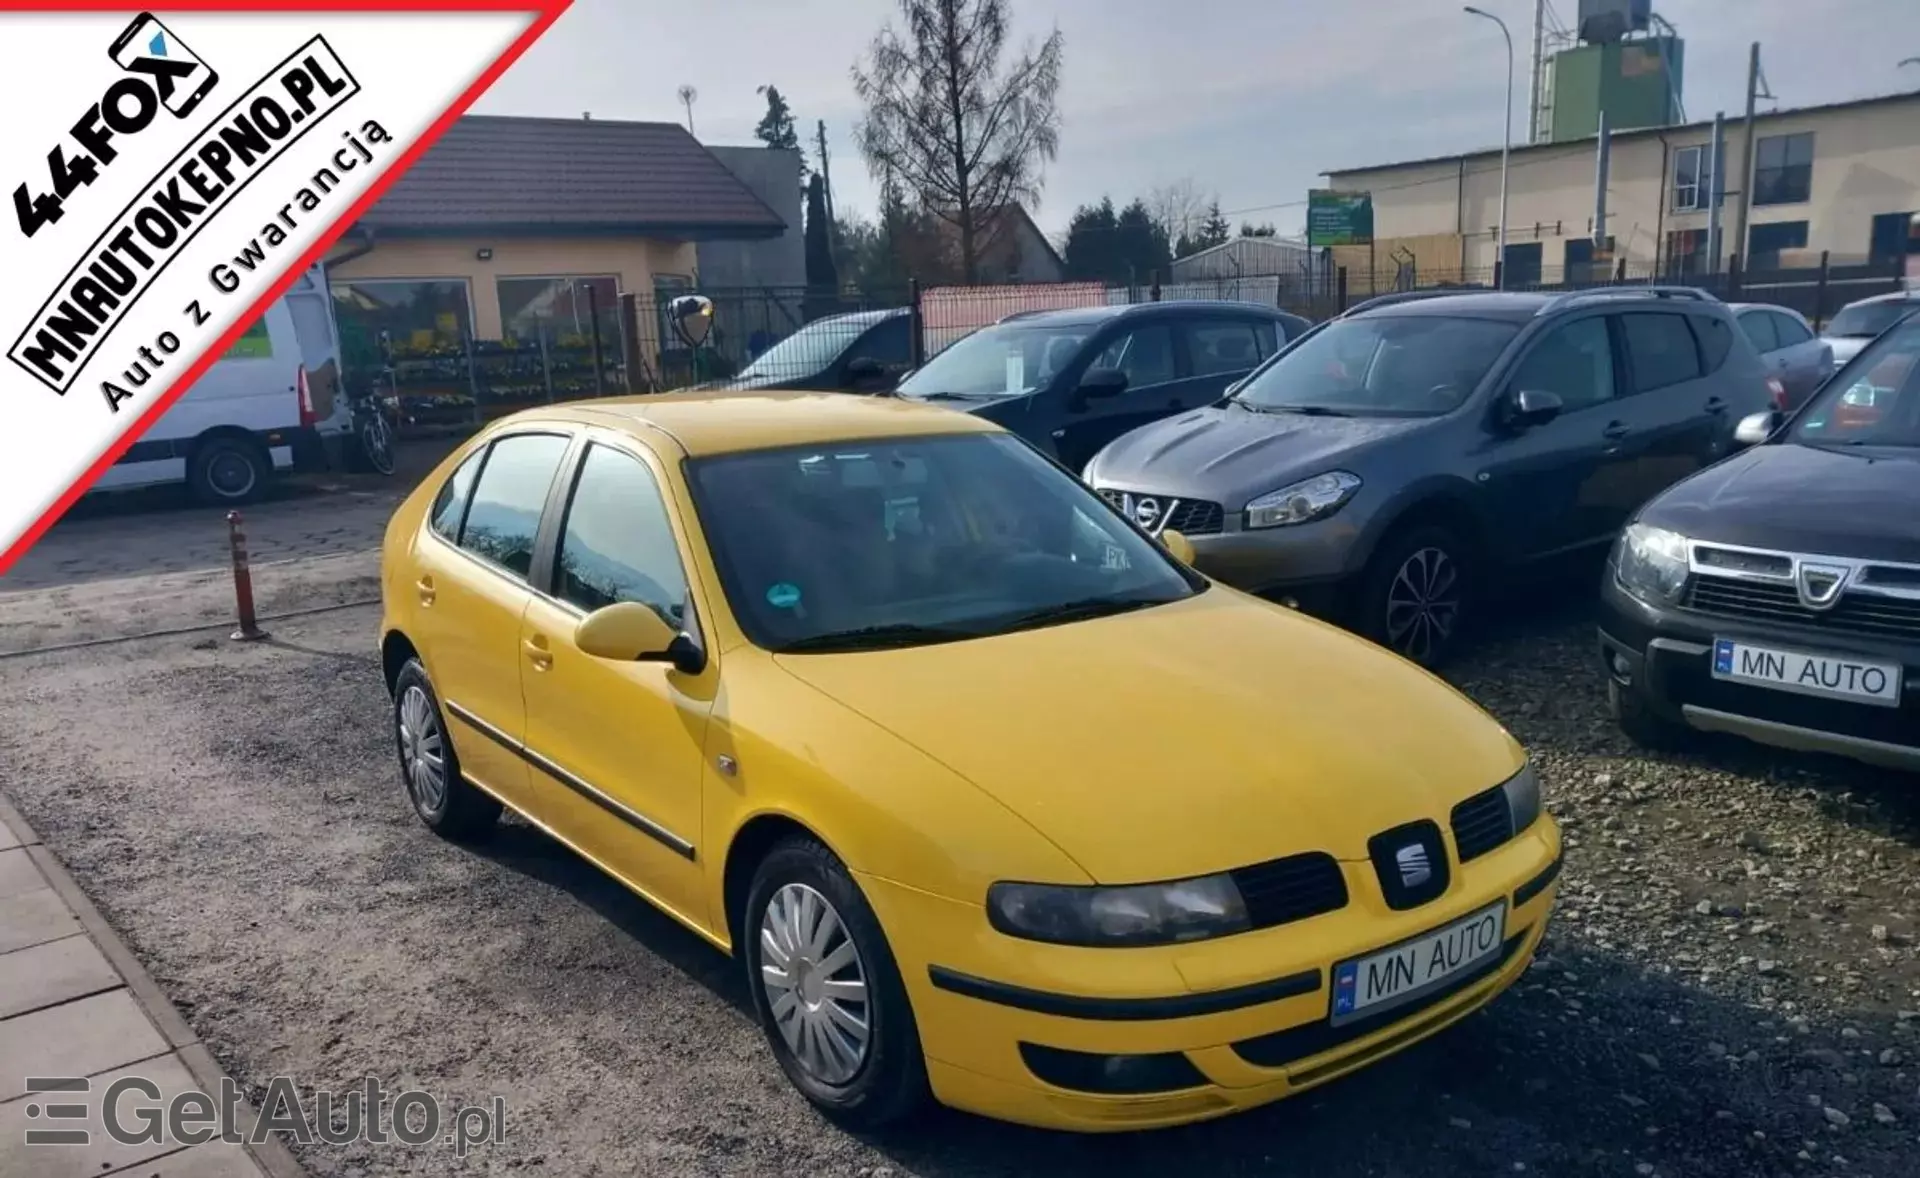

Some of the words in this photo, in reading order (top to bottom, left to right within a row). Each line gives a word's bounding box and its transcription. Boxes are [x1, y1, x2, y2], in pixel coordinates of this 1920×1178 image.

[1741, 648, 1785, 680] MN
[1798, 658, 1887, 694] AUTO
[1366, 949, 1416, 1000] MN
[1427, 914, 1496, 978] AUTO
[1337, 996, 1352, 1009] PL
